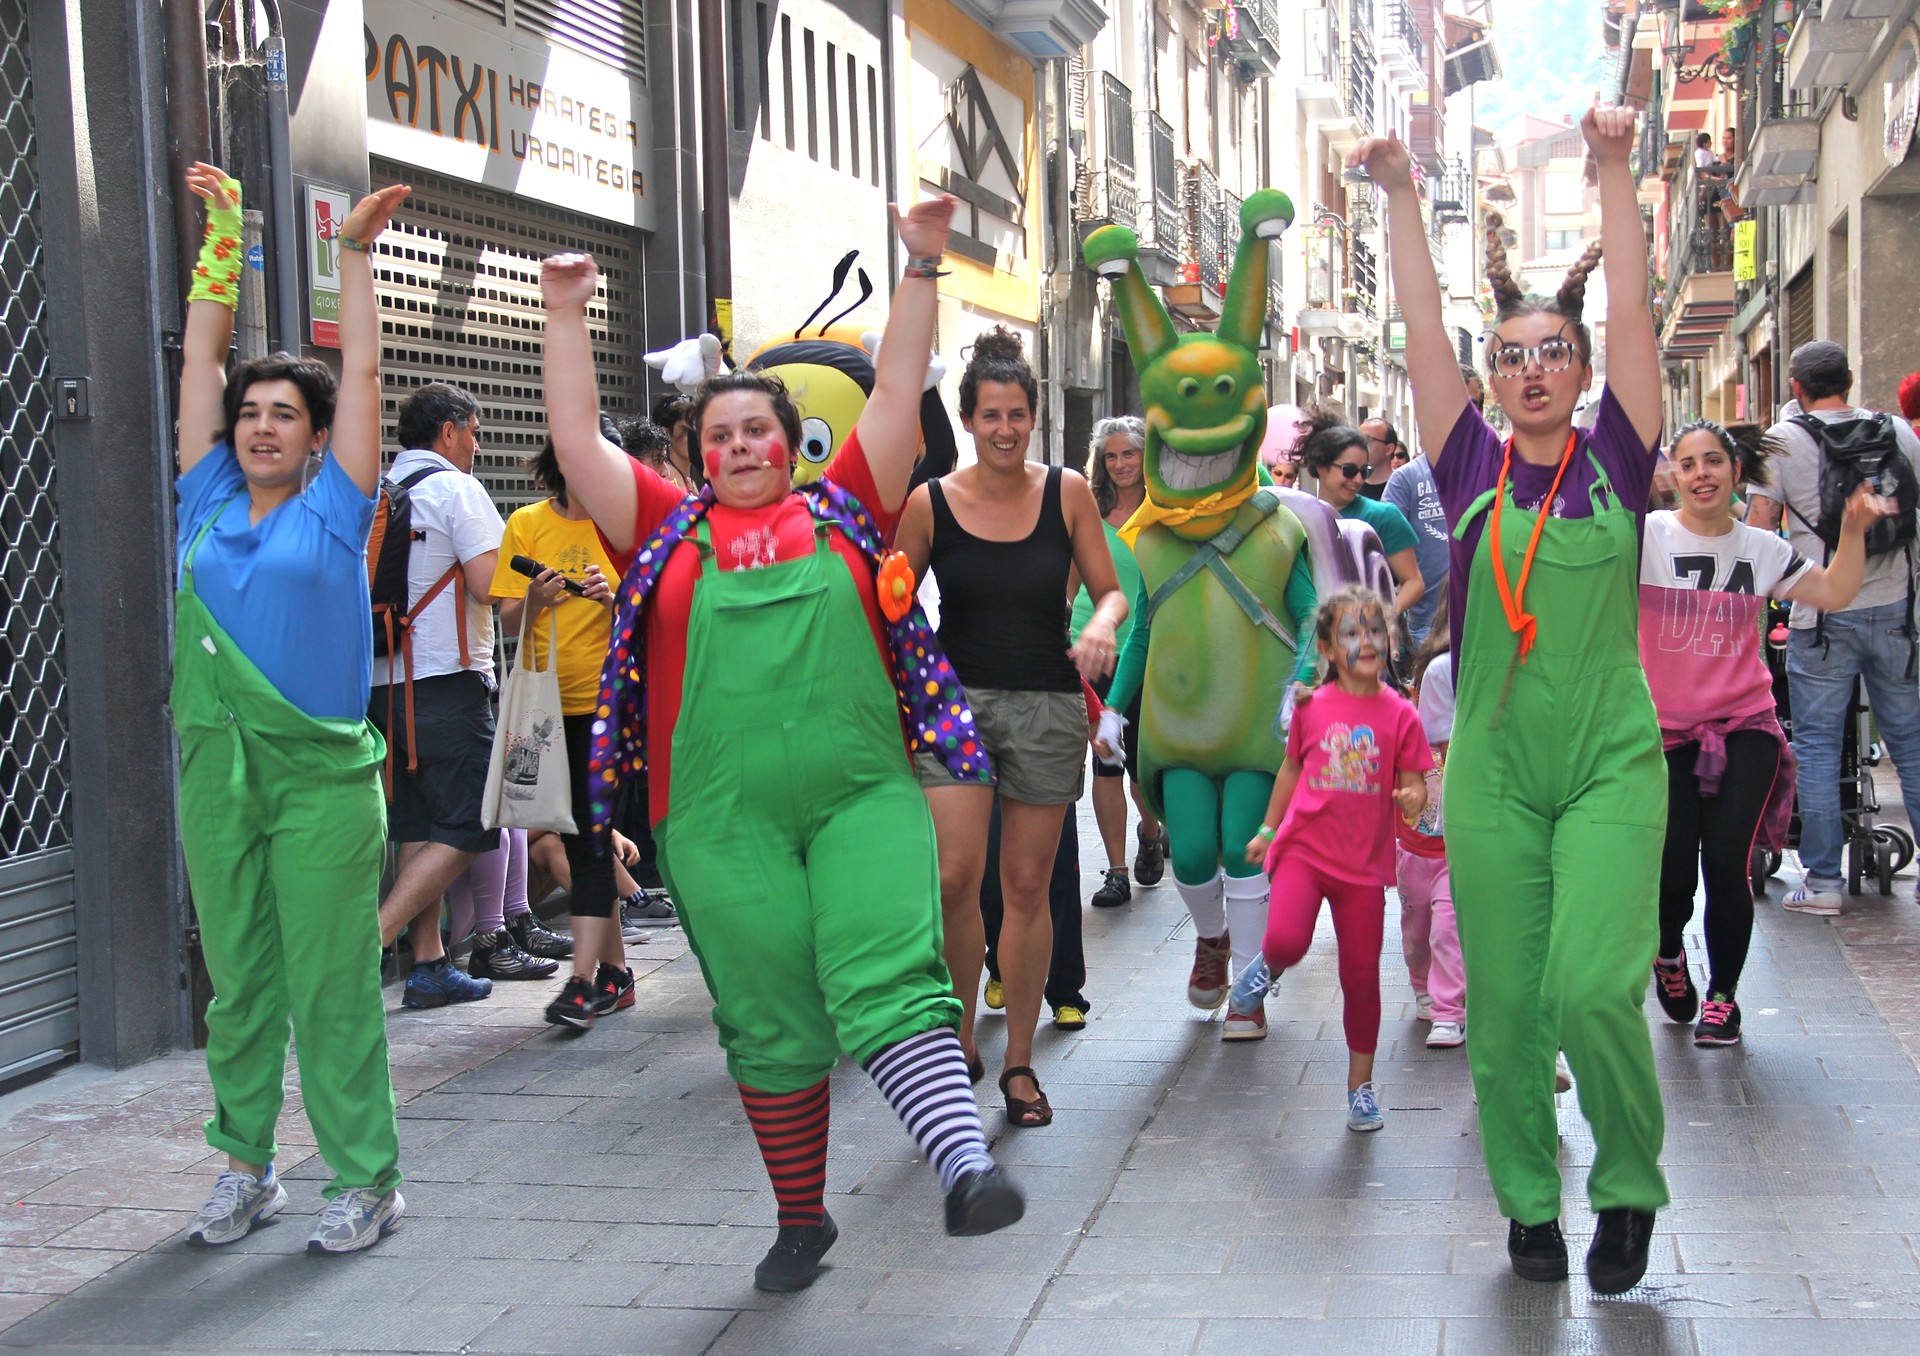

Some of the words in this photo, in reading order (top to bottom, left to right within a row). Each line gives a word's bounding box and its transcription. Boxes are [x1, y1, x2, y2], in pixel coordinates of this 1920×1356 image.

[508, 74, 637, 147] HARATEGIA
[511, 129, 644, 197] URDAITEGIA
[1417, 480, 1437, 497] CA
